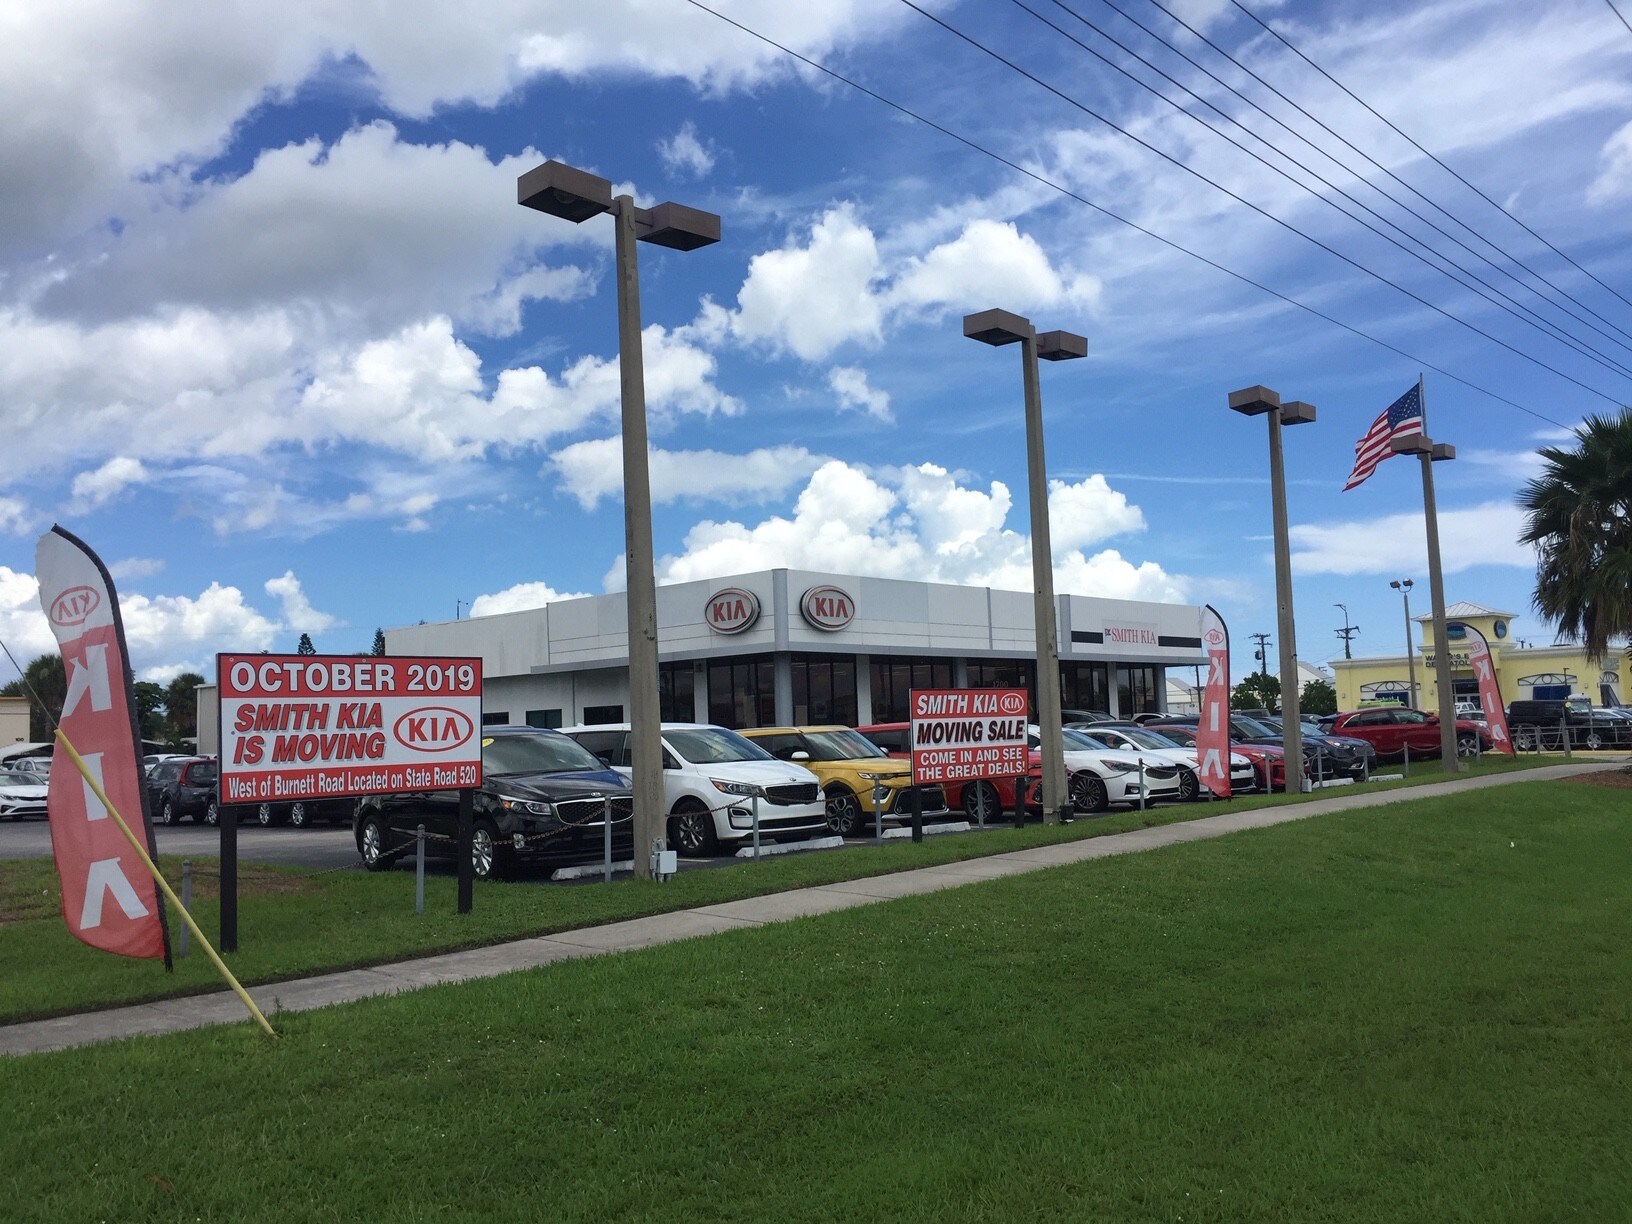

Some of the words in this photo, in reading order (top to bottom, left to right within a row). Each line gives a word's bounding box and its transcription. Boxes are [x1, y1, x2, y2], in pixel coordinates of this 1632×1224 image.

[713, 599, 747, 623] KIA
[814, 596, 849, 619] KIA
[1112, 628, 1138, 643] SMITH
[1140, 629, 1157, 645] KIA
[230, 662, 396, 692] OCTOBER
[407, 664, 475, 692] 2019
[917, 694, 969, 715] SMITH
[973, 694, 998, 714] KIA
[1004, 697, 1021, 709] KIA
[234, 703, 331, 732] SMITH
[336, 702, 383, 729] KIA
[408, 717, 461, 742] KIA
[917, 721, 983, 744] MOVING
[987, 719, 1025, 742] SALE
[233, 736, 266, 764] IS
[271, 732, 386, 763] MOVING
[920, 751, 956, 766] COME
[960, 750, 972, 763] IN
[976, 749, 999, 762] AND
[1002, 748, 1022, 760] SEE
[228, 777, 257, 798] West
[260, 775, 272, 796] of
[274, 774, 315, 796] Burnett
[318, 771, 345, 793] Road
[347, 769, 388, 791] Located
[390, 772, 403, 789] on
[405, 767, 431, 787] State
[433, 766, 457, 786] Road
[459, 765, 476, 784] 520
[918, 767, 942, 780] THE
[946, 764, 984, 778] GREAT
[988, 761, 1025, 775] DEALS!
